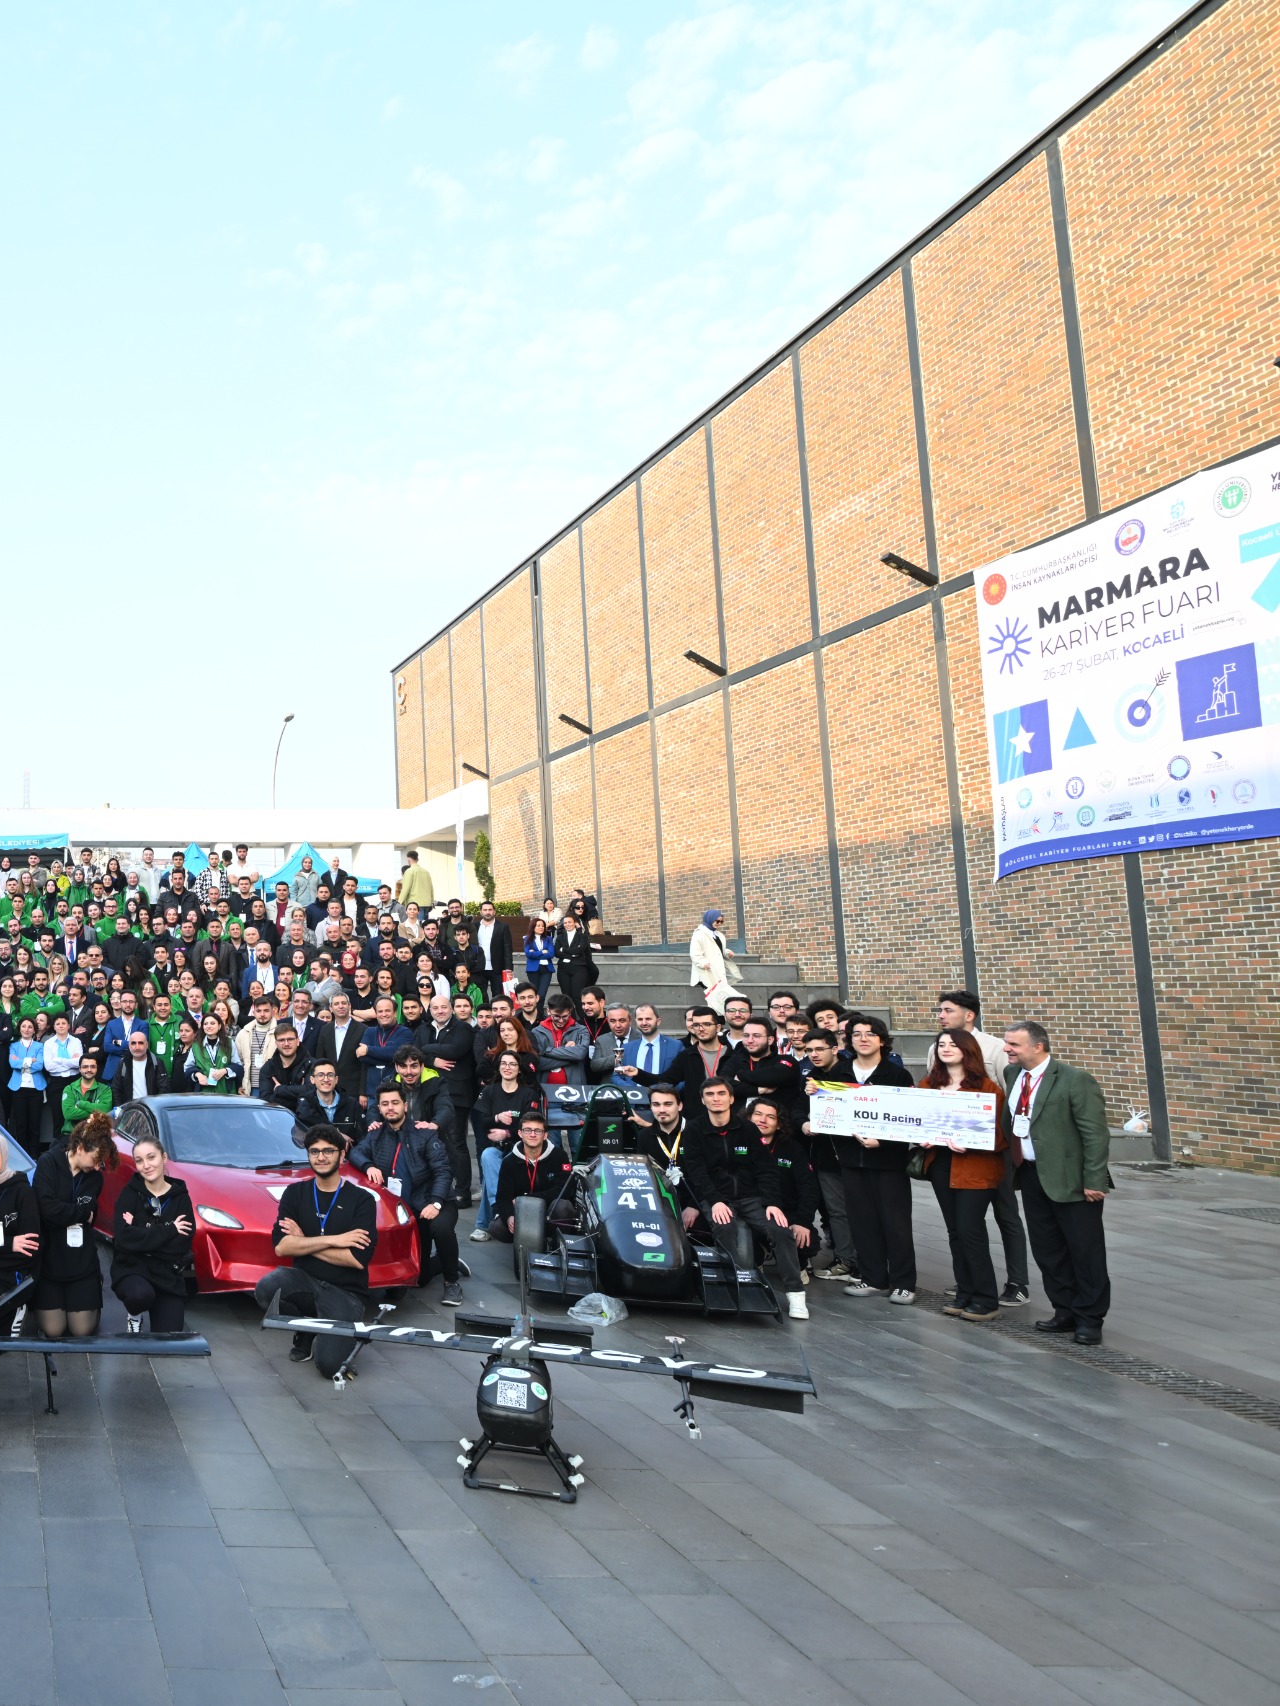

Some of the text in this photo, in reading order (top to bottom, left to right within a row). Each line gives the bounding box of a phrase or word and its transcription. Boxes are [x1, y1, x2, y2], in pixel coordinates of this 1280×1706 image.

[1011, 553, 1098, 591] İNSAN KAYNAKLARI OFİSİ
[1037, 547, 1210, 629] MARMARA
[1040, 581, 1220, 659] KARİYER FUARI
[1042, 662, 1072, 681] 26-27
[1122, 623, 1185, 657] KOCAELİ
[1005, 853, 1037, 868] BÖLGESEL
[1040, 848, 1069, 857] KARİYER
[1072, 842, 1110, 852] FUARLARI
[854, 1110, 922, 1126] KOU Racing
[618, 1192, 657, 1210] 41
[632, 1222, 660, 1230] KR-01
